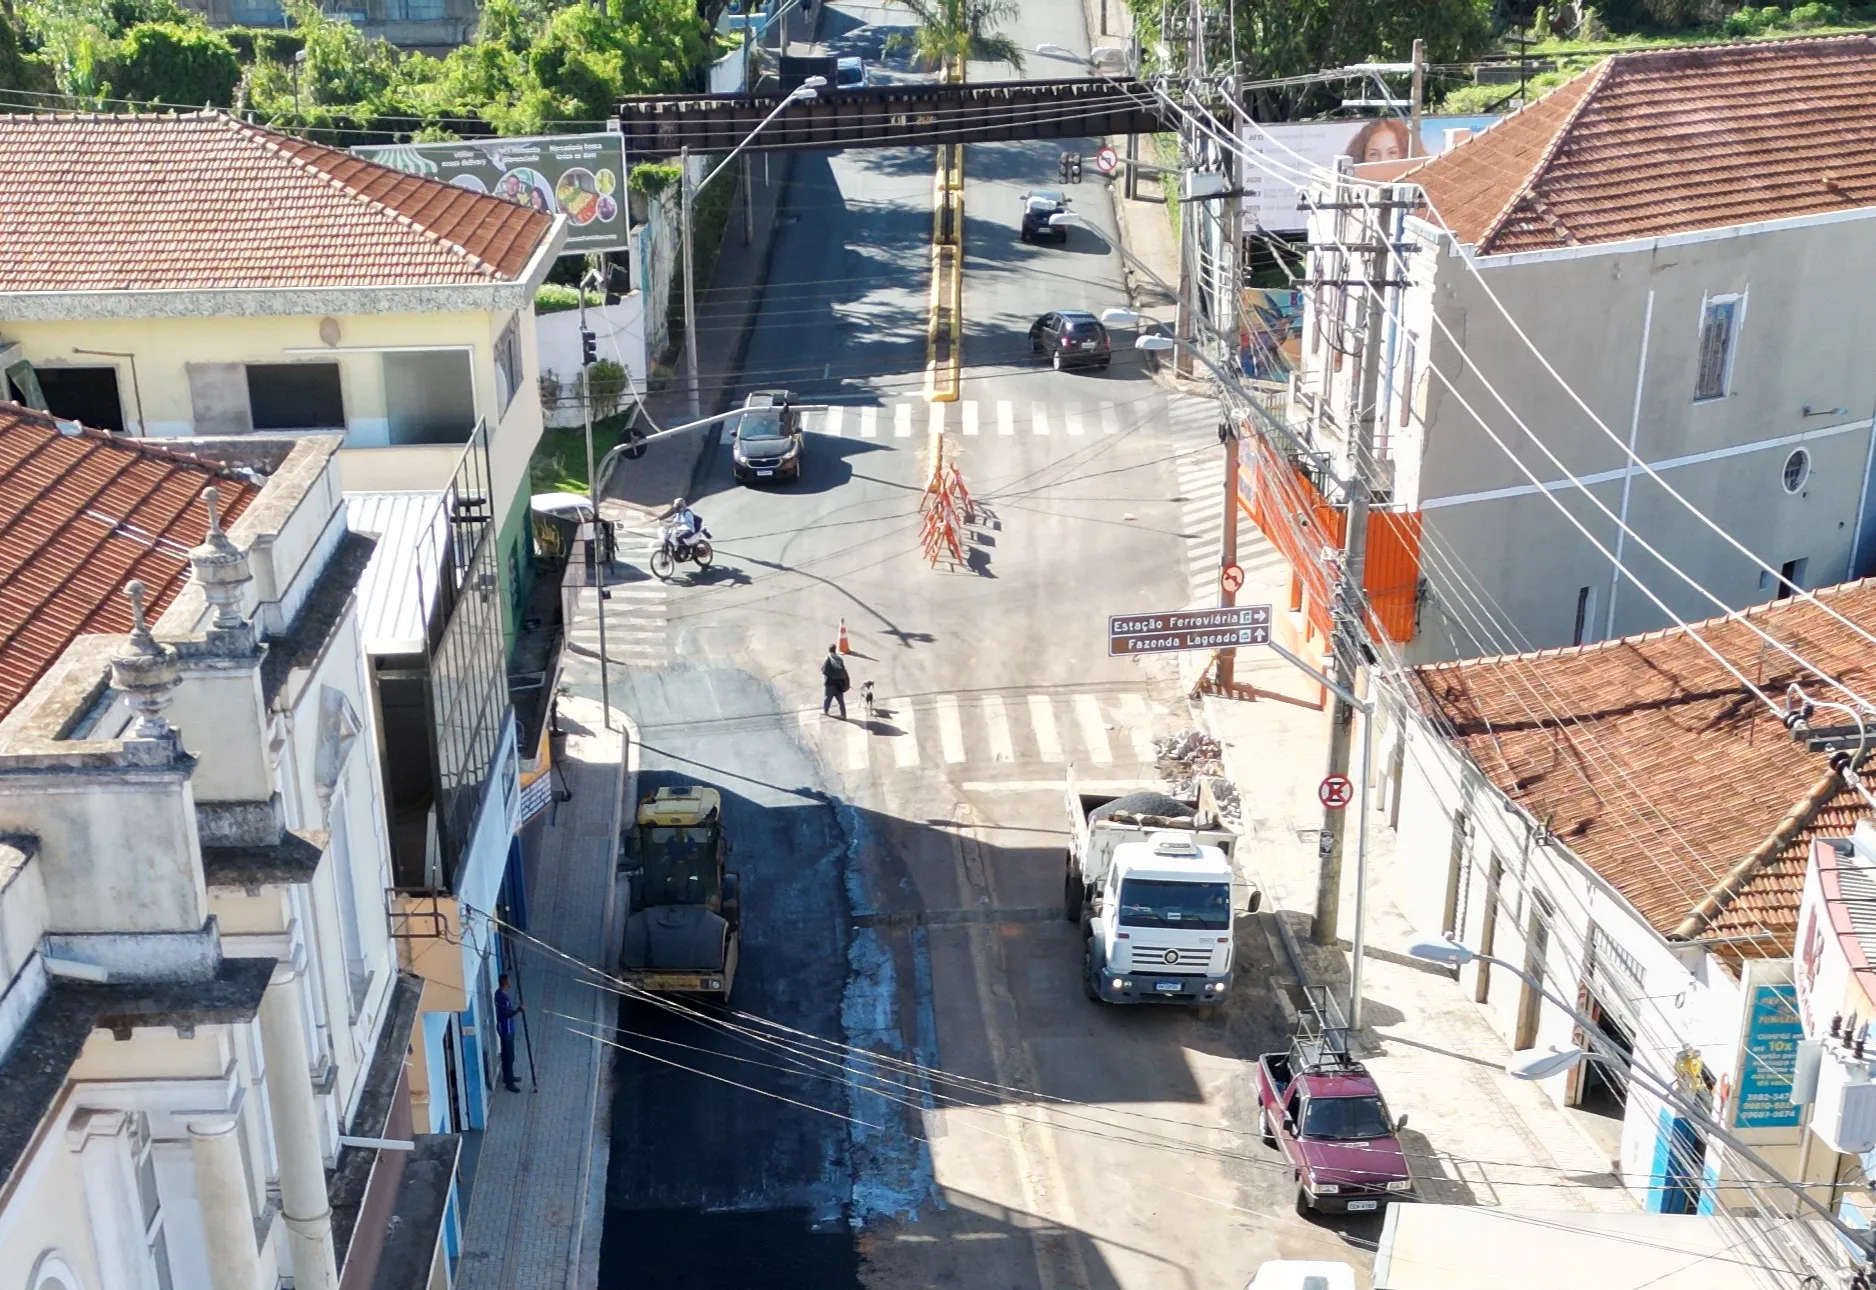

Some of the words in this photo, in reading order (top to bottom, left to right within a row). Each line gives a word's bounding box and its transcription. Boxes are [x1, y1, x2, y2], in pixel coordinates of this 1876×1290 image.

[1114, 618, 1163, 632] Estação
[1169, 613, 1238, 629] Ferroviária
[1128, 636, 1180, 650] Fazenda
[1186, 632, 1238, 646] Lageado
[1769, 1040, 1794, 1051] 10x
